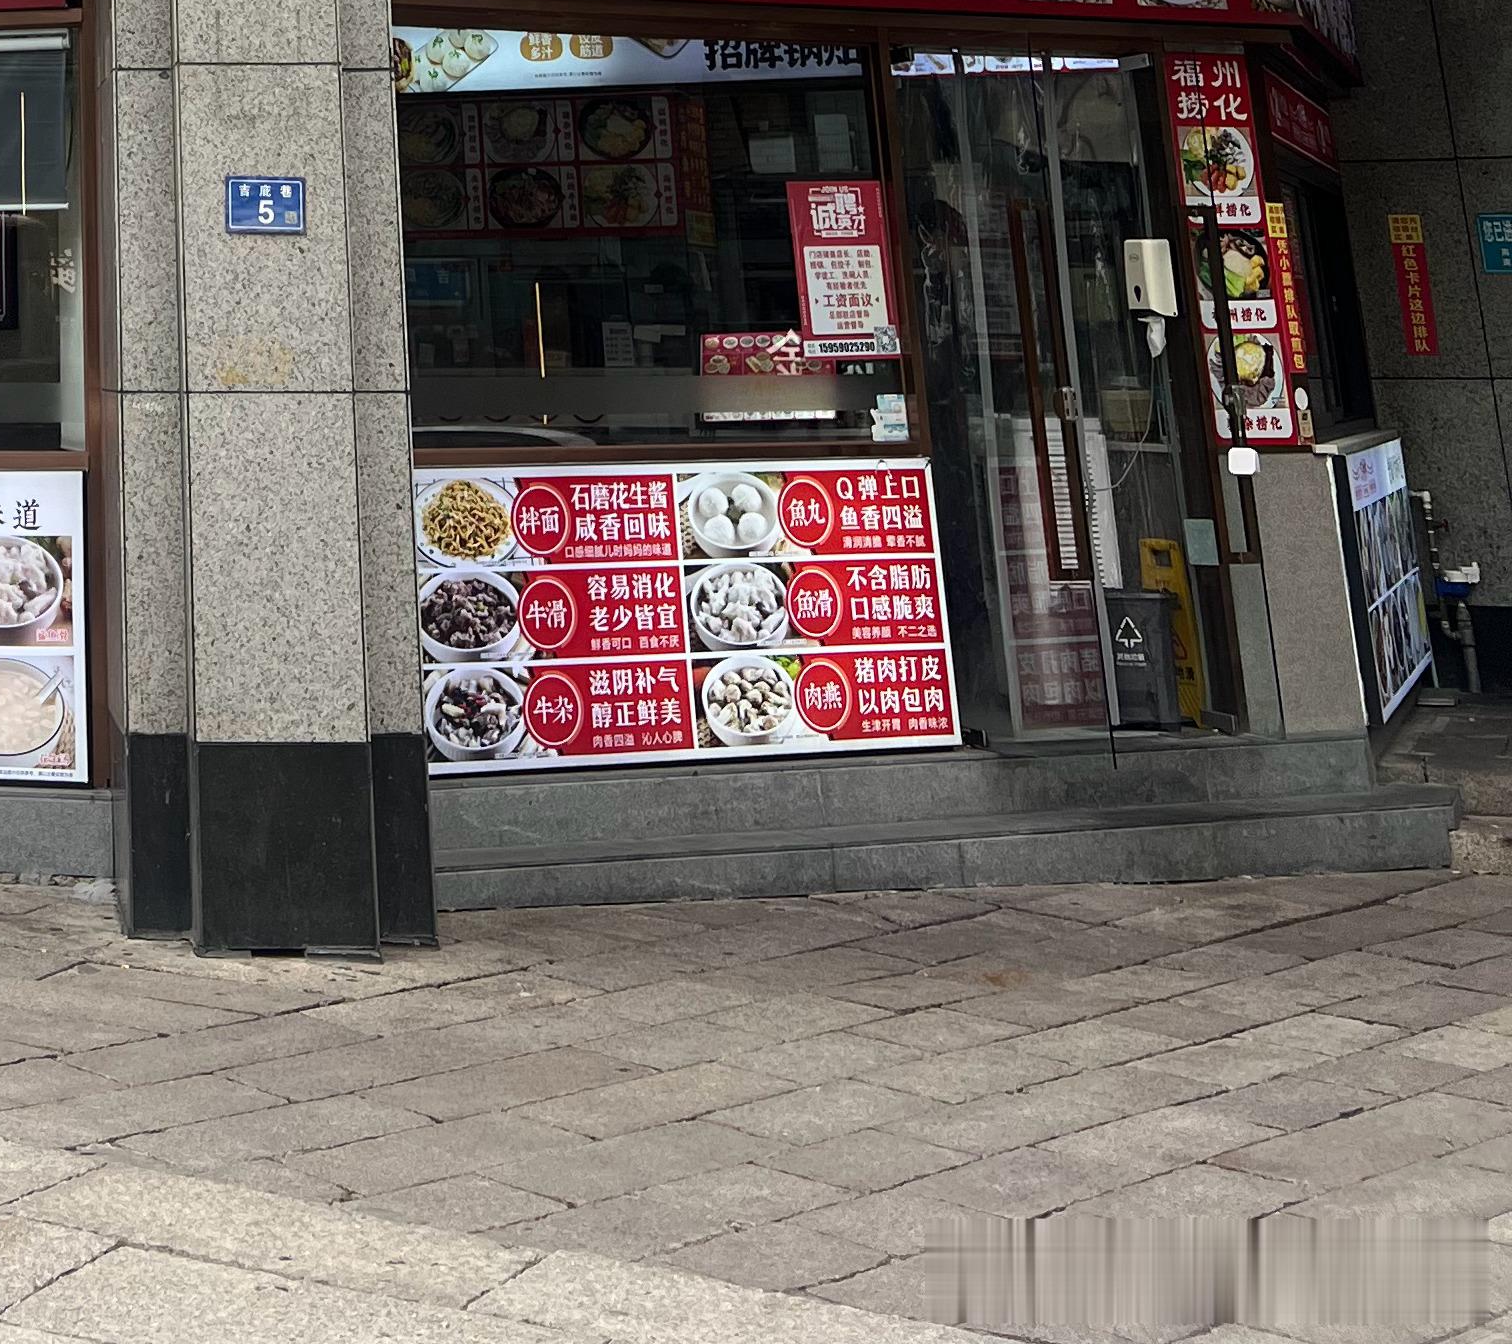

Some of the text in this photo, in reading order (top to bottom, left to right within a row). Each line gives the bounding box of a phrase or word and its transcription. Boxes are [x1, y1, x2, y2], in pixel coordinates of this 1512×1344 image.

[1171, 60, 1241, 88] 福州
[1176, 91, 1248, 121] 捞化
[258, 200, 274, 224] 5
[823, 293, 873, 308] 工资面议
[1401, 245, 1431, 352] 红色卡片这边排队
[1212, 307, 1266, 322] 州捞化
[1243, 415, 1282, 432] 杂捞化
[570, 481, 668, 510] 石磨花生酱
[519, 506, 560, 535] 拌面
[575, 512, 671, 542] 咸香回味
[839, 505, 925, 531] 鱼香四溢
[587, 572, 677, 601] 容易消化
[846, 565, 931, 592] 不含脂肪
[525, 599, 568, 629] 牛滑
[588, 603, 678, 633] 老少皆宜
[850, 594, 936, 621] 口感脆爽
[590, 637, 632, 651] 鲜香可口
[589, 666, 680, 696] 滋阴补气
[854, 655, 942, 683] 猪肉打皮
[533, 695, 574, 724] 牛杂
[804, 682, 843, 710] 肉燕
[858, 687, 944, 715] 以肉包肉
[591, 698, 682, 729] 醇正鲜美
